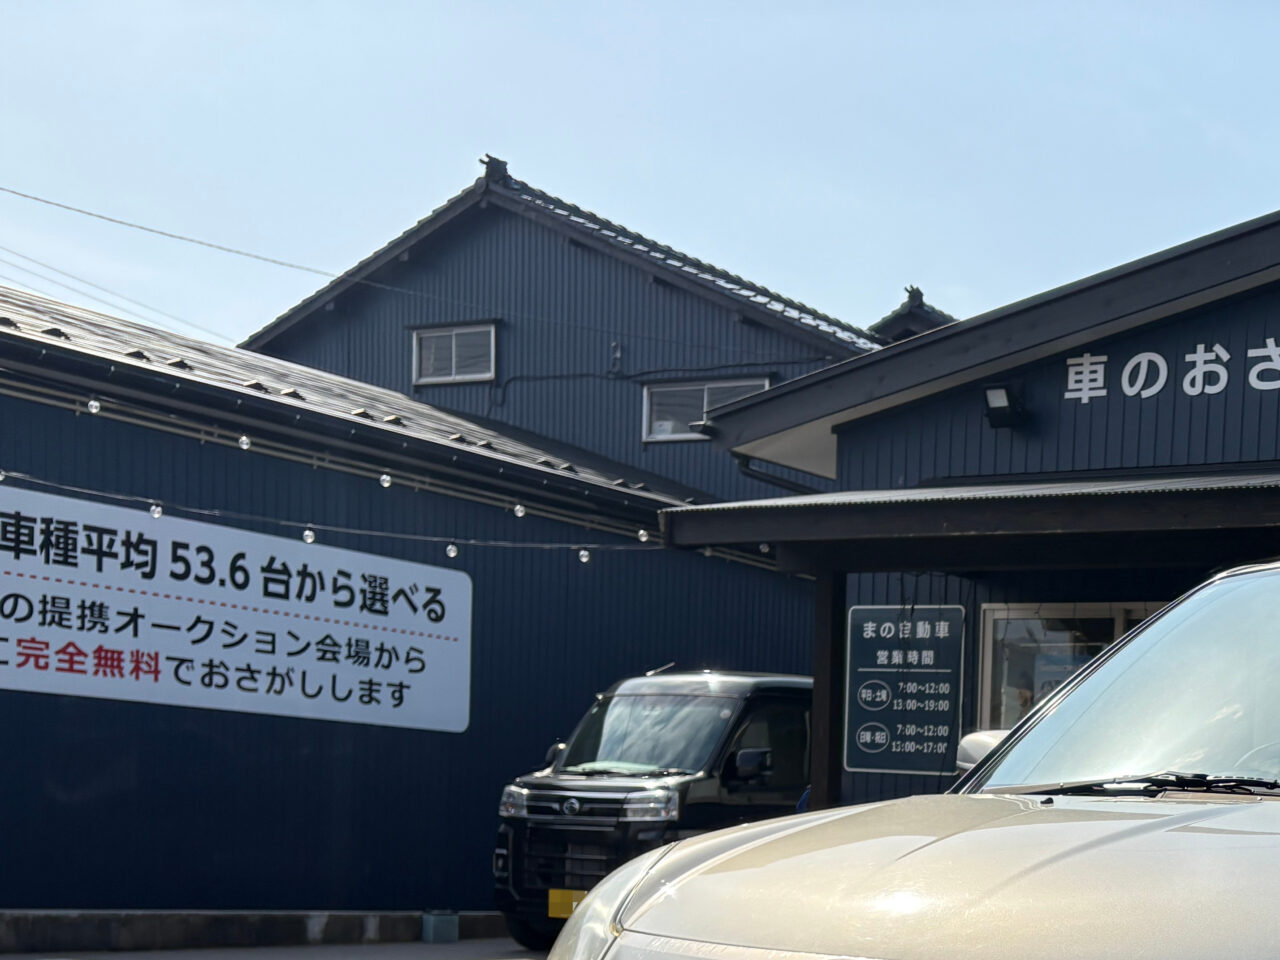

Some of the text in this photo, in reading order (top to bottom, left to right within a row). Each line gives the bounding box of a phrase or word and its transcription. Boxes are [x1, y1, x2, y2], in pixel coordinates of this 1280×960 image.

[0, 593, 426, 674] の提携オークション会場から
[877, 650, 934, 666] 営業時間
[0, 636, 411, 708] 完全無料でおさがしします
